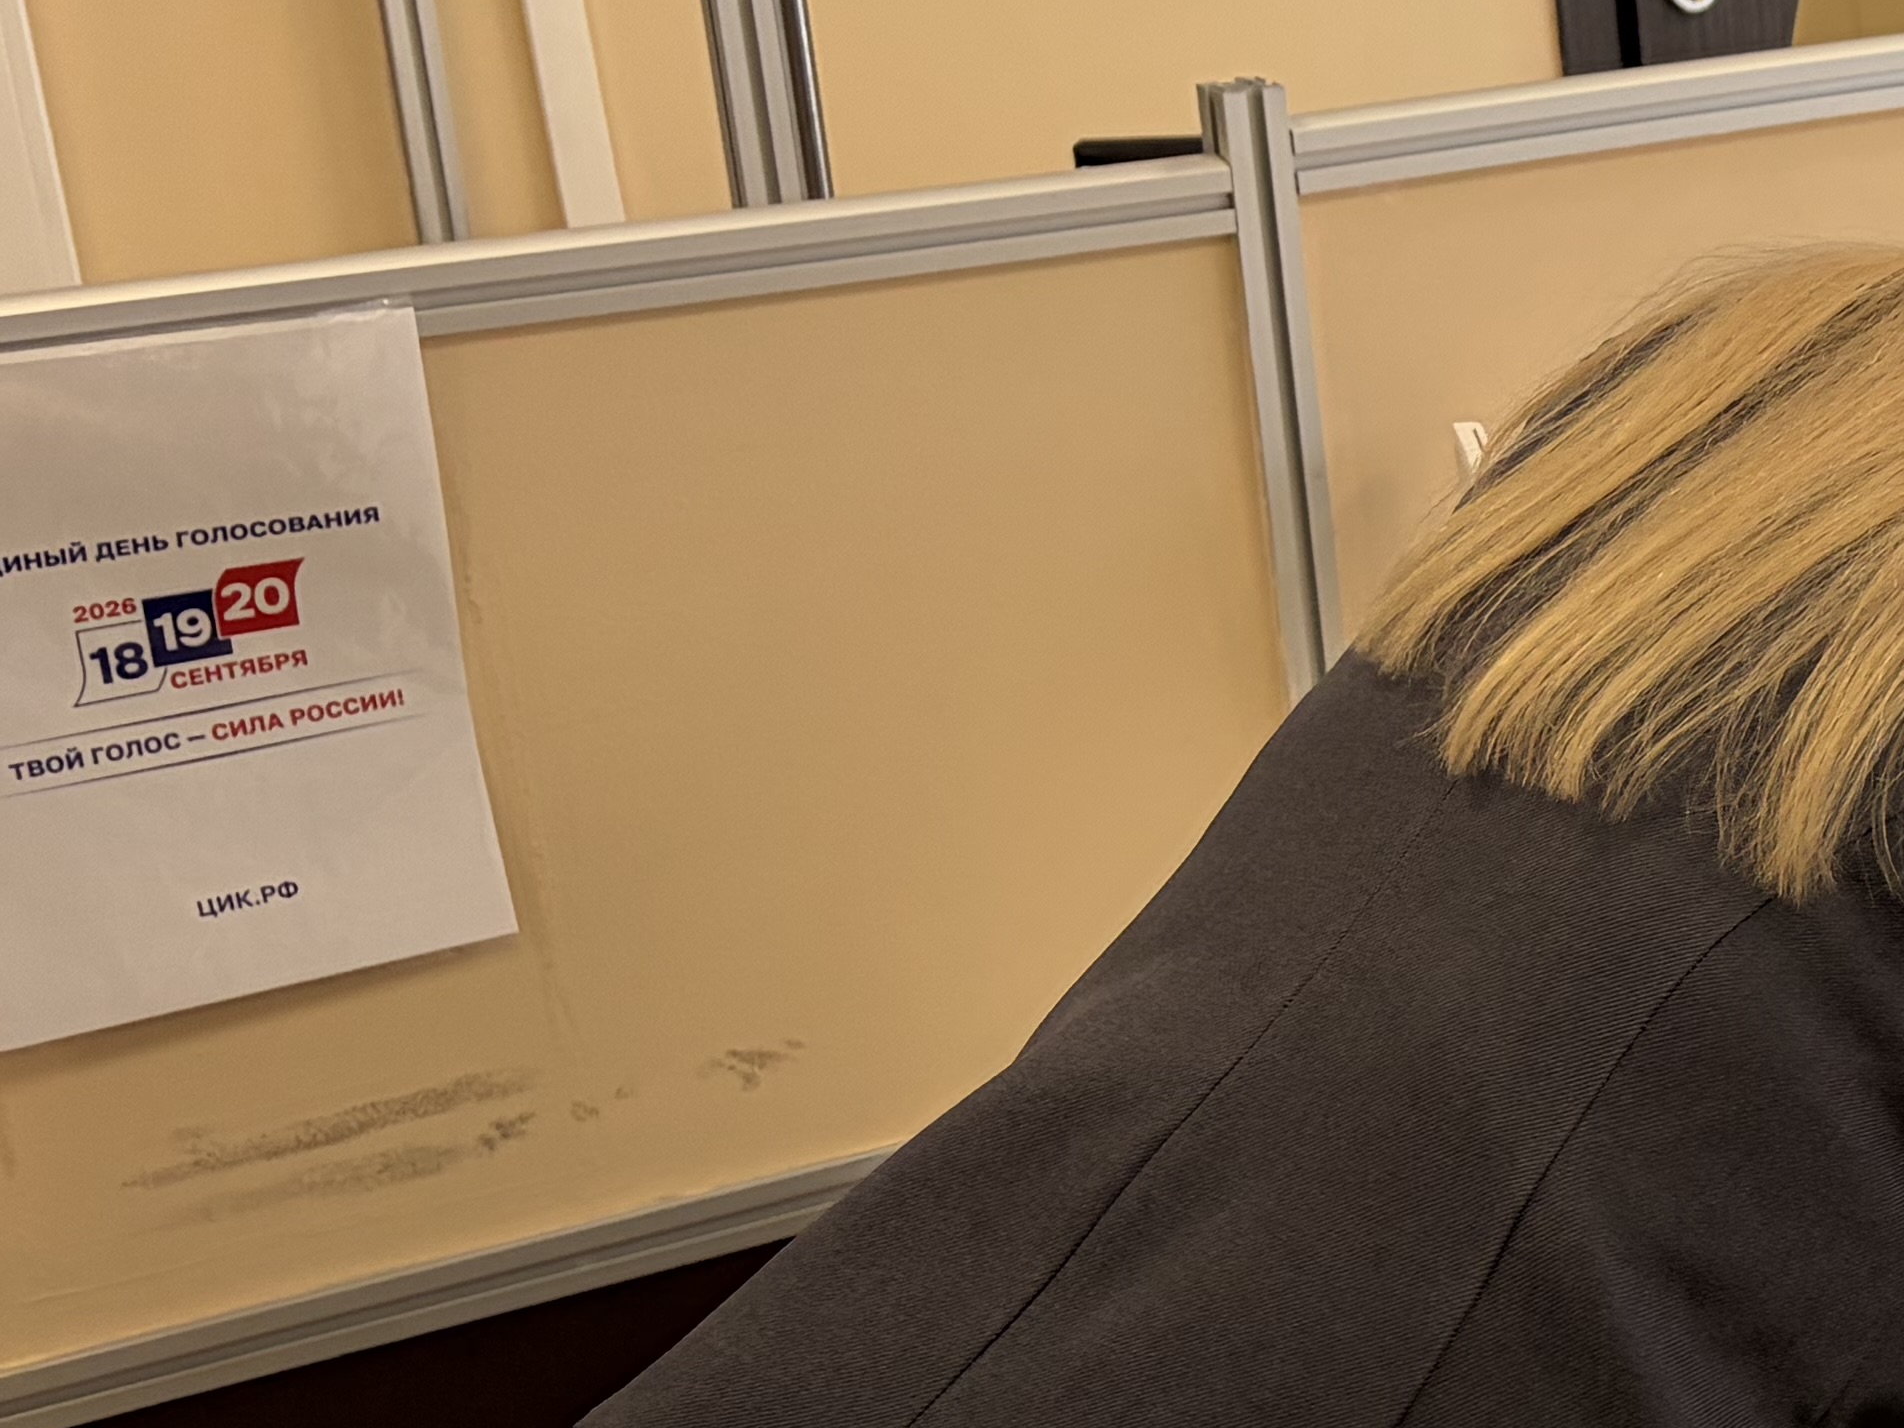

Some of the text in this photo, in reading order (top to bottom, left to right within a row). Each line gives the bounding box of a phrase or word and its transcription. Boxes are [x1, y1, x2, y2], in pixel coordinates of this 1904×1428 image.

[0, 506, 380, 577] ИНЫЙ ДЕНЬ ГОЛОСОВАНИЯ
[72, 597, 137, 623] 2026
[220, 577, 290, 621] 20
[153, 608, 212, 652] 19
[89, 641, 149, 685] 18
[170, 649, 309, 689] СЕНТЯБРЯ
[9, 747, 85, 781] ТВОЙ
[91, 732, 181, 765] ГОЛОС
[211, 712, 284, 741] СИЛА
[290, 688, 405, 726] РОССИИ!
[197, 879, 299, 919] ЦИК.РФ
